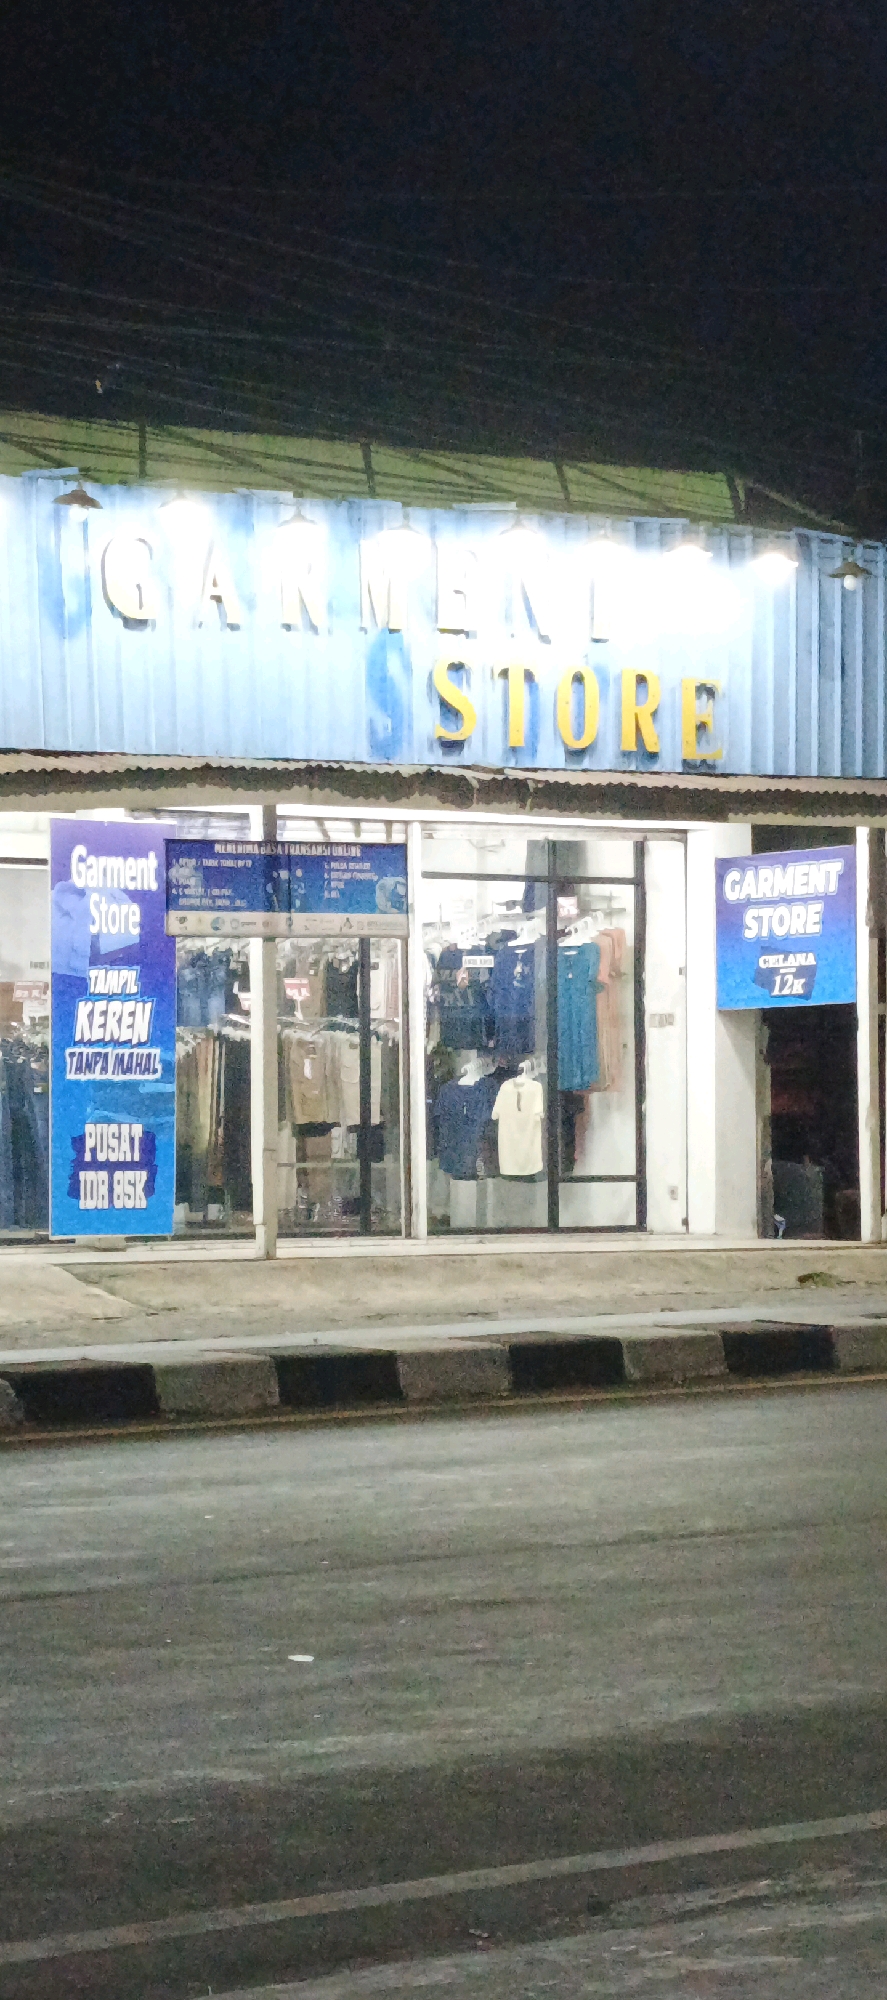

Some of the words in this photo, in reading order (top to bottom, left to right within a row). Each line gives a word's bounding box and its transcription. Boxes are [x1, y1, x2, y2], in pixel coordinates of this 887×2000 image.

[433, 655, 723, 761] STORE
[71, 844, 158, 891] Garment
[724, 861, 843, 901] GARMENT
[89, 892, 141, 935] Store
[743, 902, 823, 939] STORE
[758, 952, 817, 969] CELANA
[88, 968, 138, 996] TAMPIL
[74, 1000, 153, 1047] KEREN
[68, 1051, 110, 1077] TANPA
[111, 1051, 160, 1077] MAHAL
[84, 1123, 144, 1162] PUSAT
[78, 1170, 109, 1210] IDR
